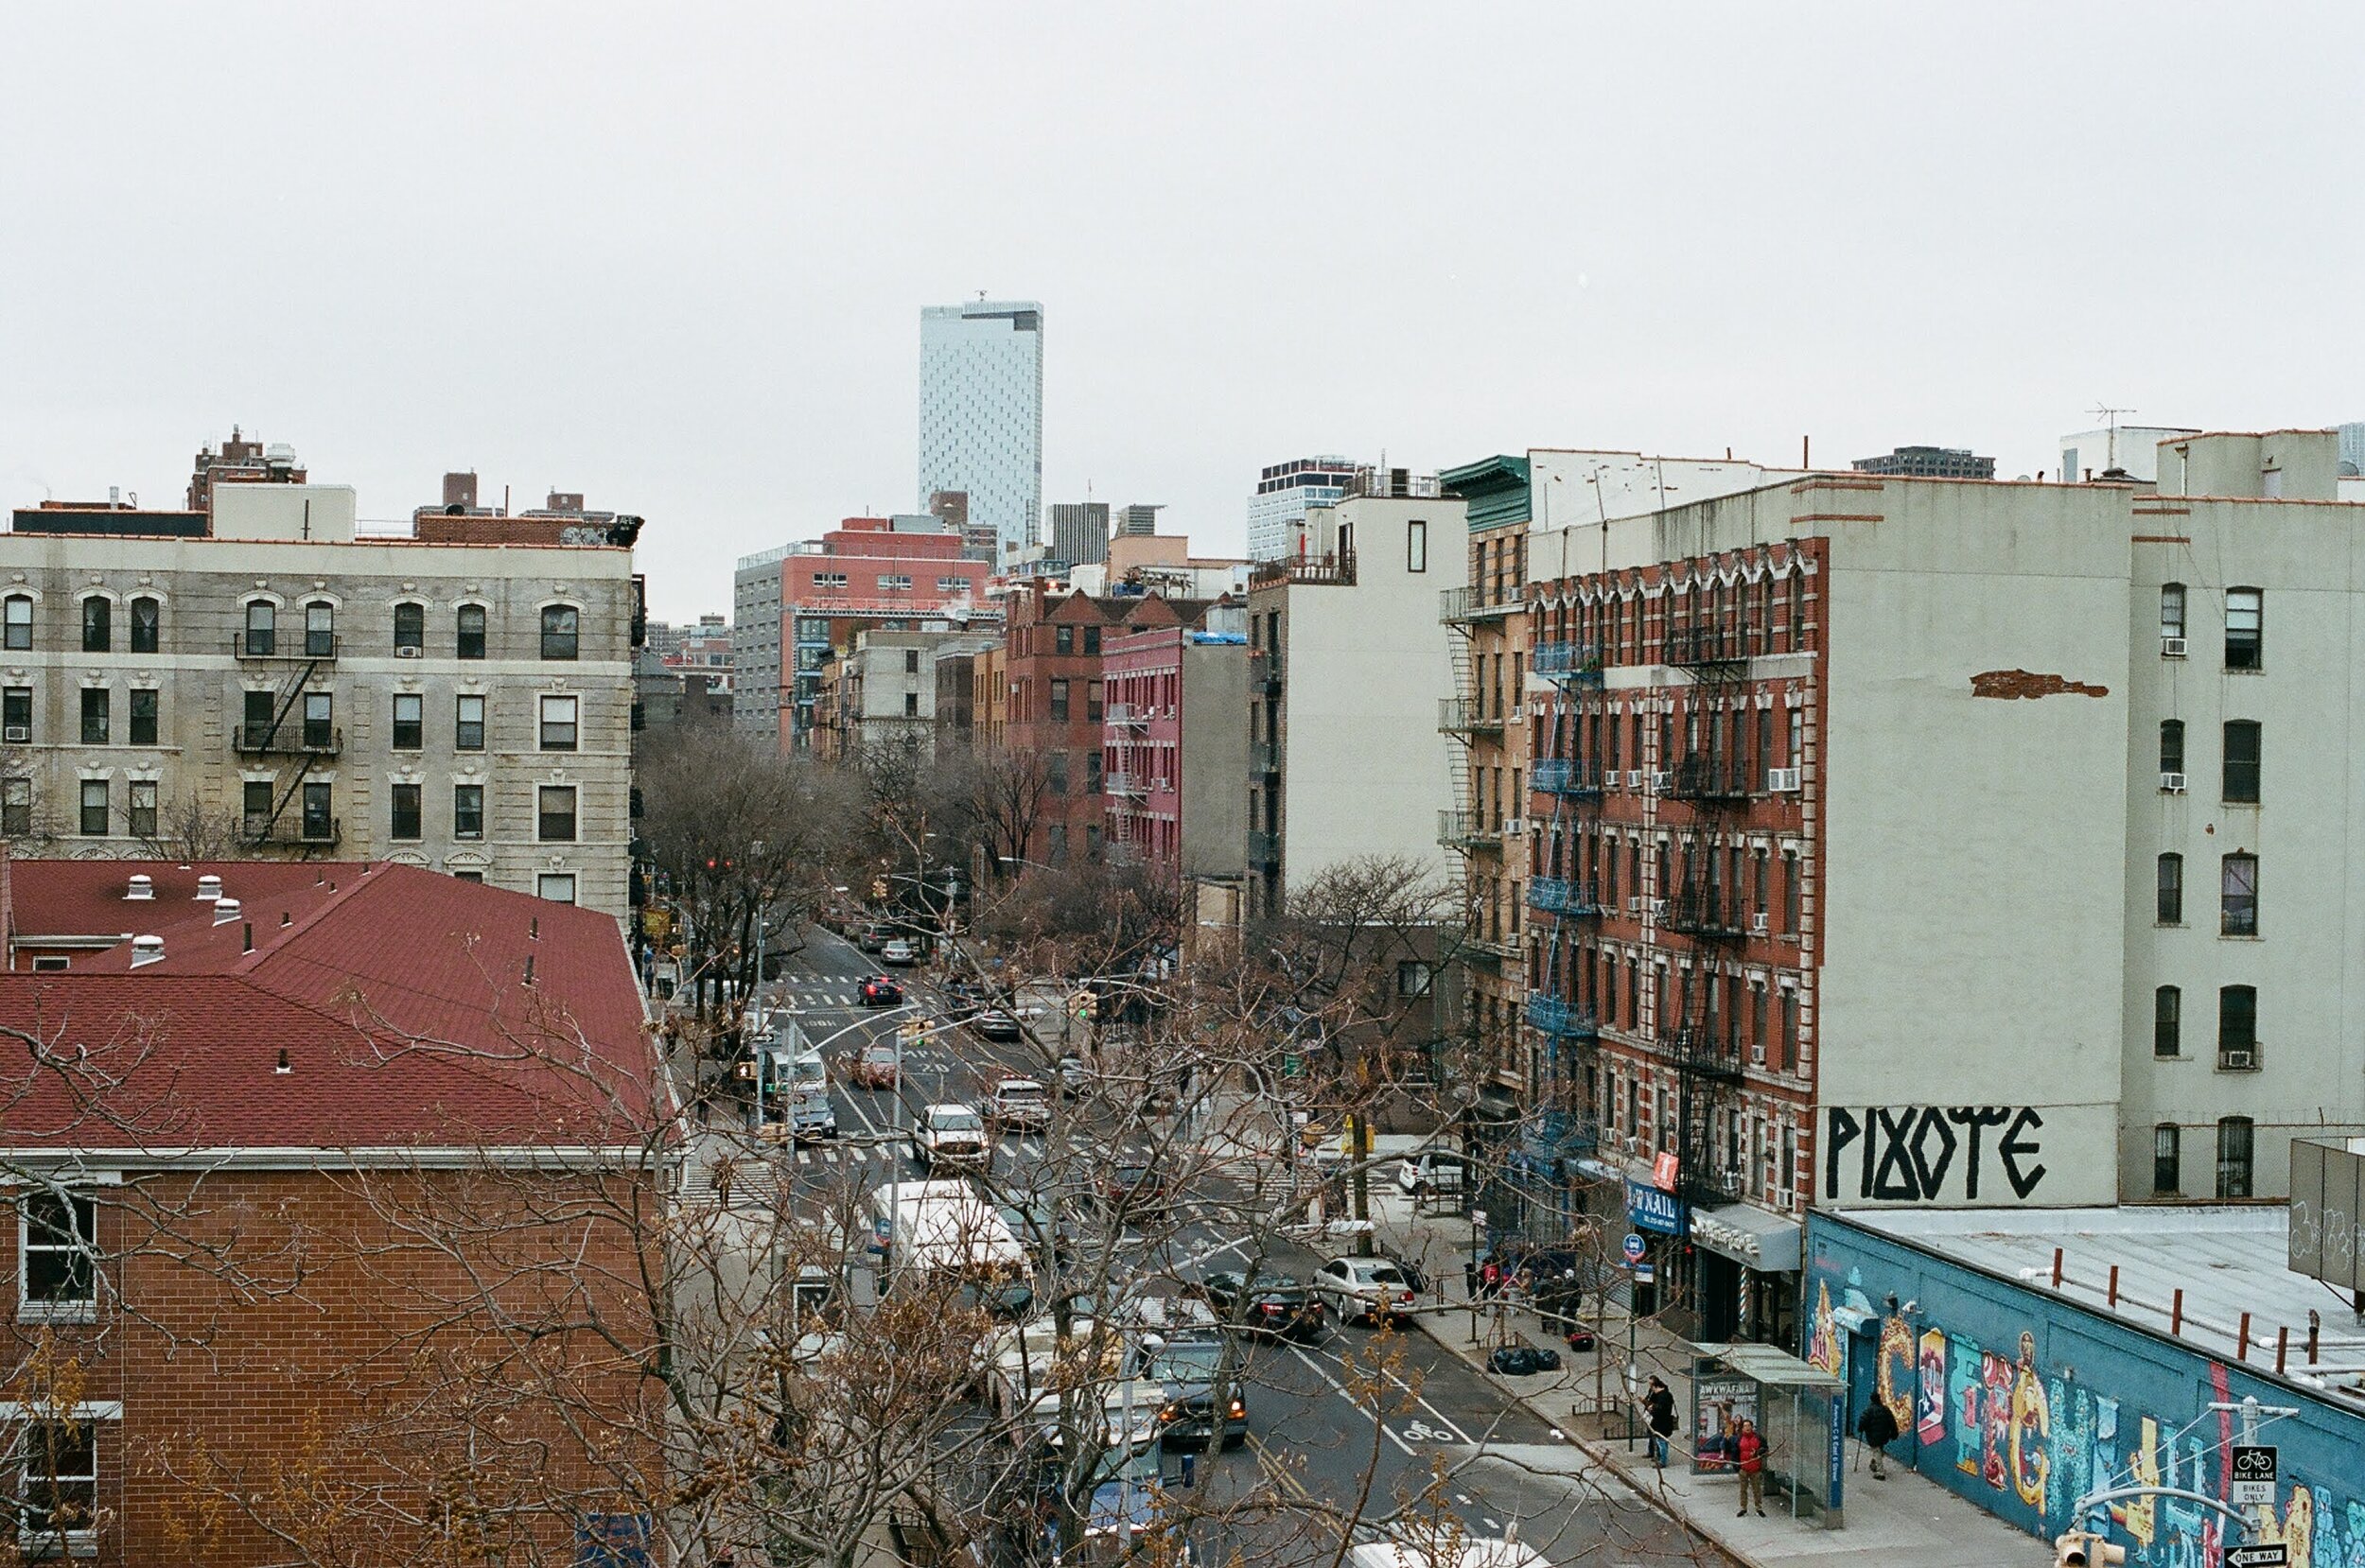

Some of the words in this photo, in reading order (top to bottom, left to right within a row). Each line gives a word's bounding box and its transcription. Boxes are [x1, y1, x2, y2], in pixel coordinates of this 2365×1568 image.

[1826, 1106, 2046, 1201] PIXOTE
[1644, 1191, 1675, 1219] NAIL
[2235, 1553, 2255, 1562] ONE
[2259, 1551, 2279, 1561] WAY
